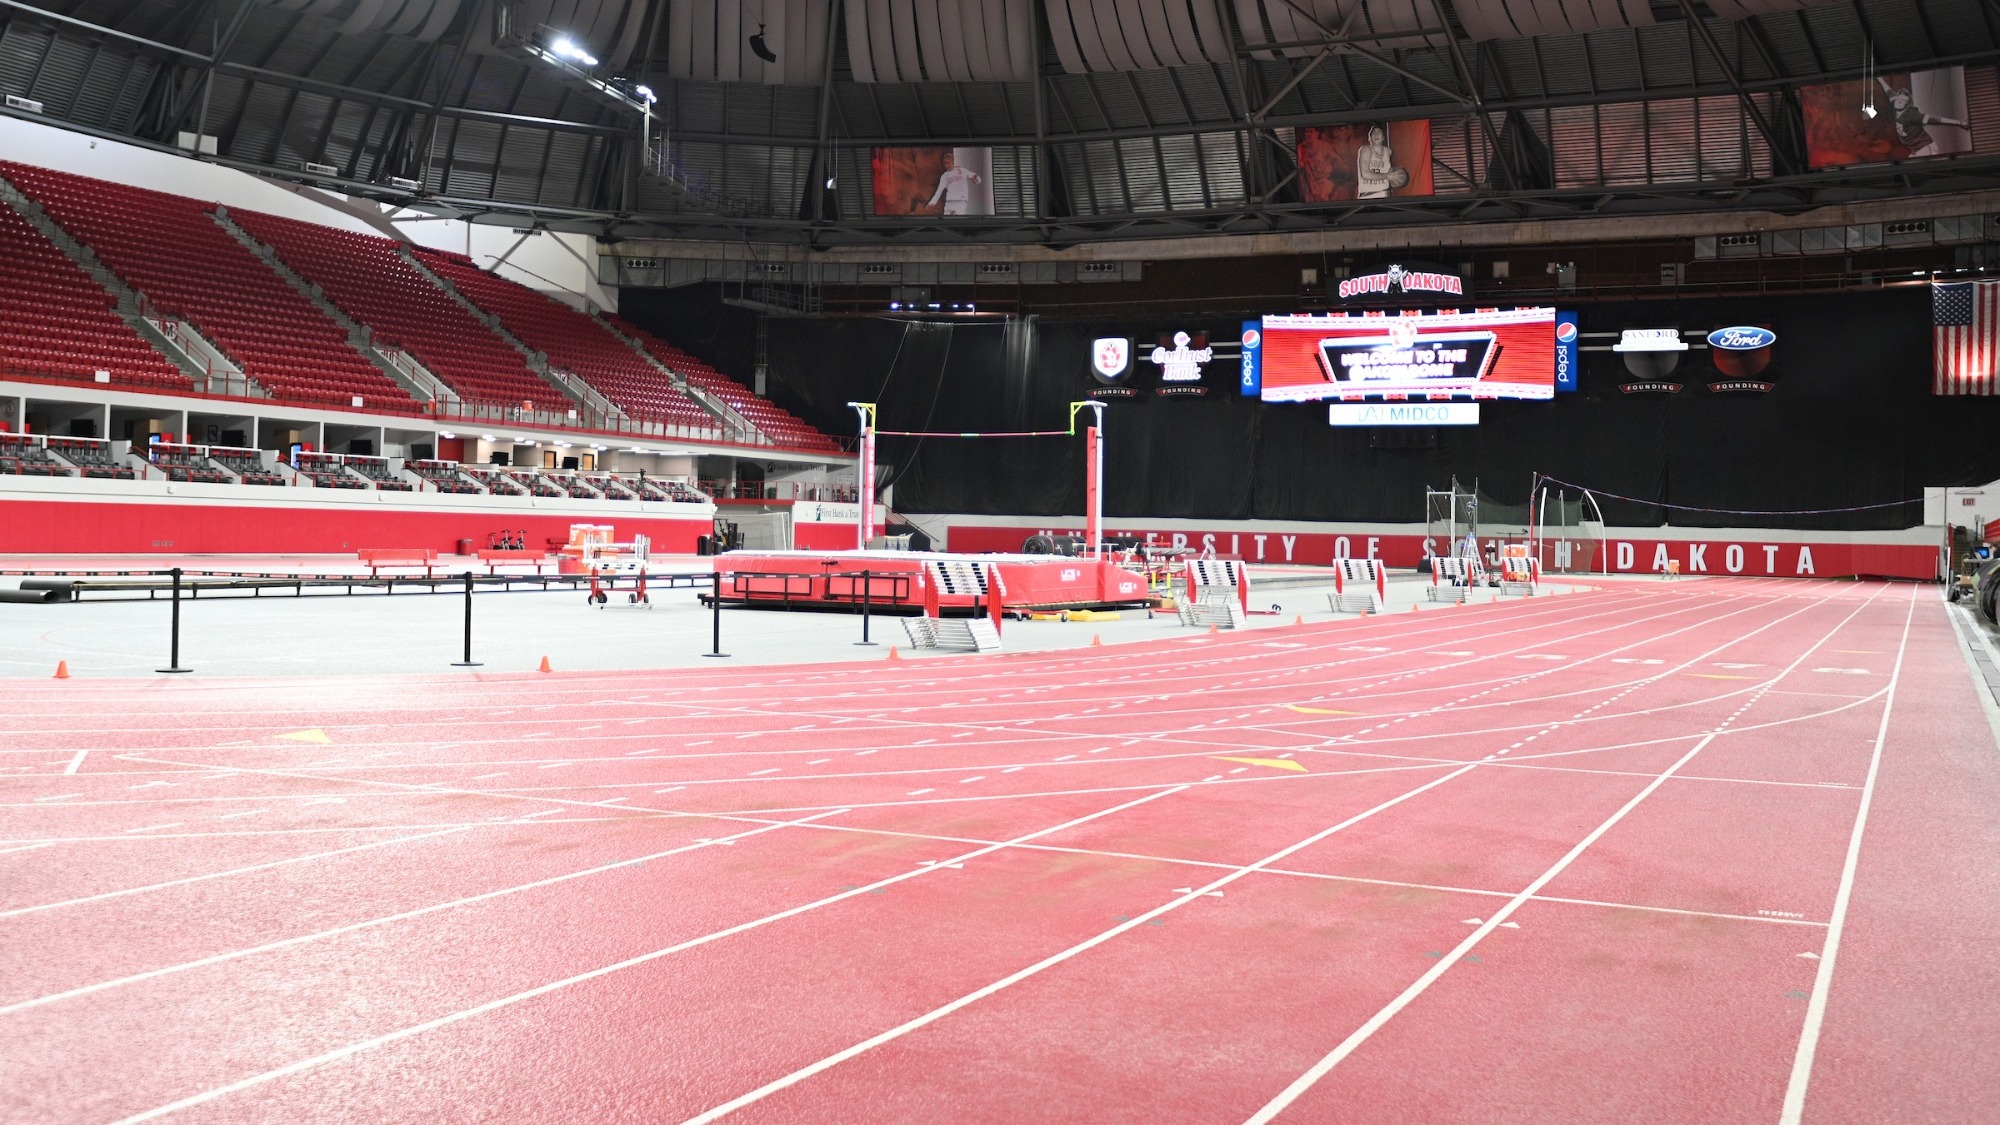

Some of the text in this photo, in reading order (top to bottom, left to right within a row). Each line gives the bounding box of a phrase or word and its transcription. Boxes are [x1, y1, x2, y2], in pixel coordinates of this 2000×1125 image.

[1339, 272, 1463, 298] SOUTH DAKOTA
[1719, 329, 1763, 347] Ford
[1152, 347, 1212, 363] CorTrust
[1415, 350, 1436, 364] TO
[1438, 349, 1467, 363] THE
[1242, 351, 1253, 386] pepsi
[1557, 345, 1569, 382] pepsi
[1163, 364, 1201, 381] Bank
[1627, 383, 1674, 391] FOUNDING
[1716, 382, 1765, 390] FOUNDING
[1390, 406, 1449, 421] MIDCO
[833, 508, 844, 518] Bank
[1335, 536, 1380, 561] OF
[1617, 542, 1815, 575] DAKOTA
